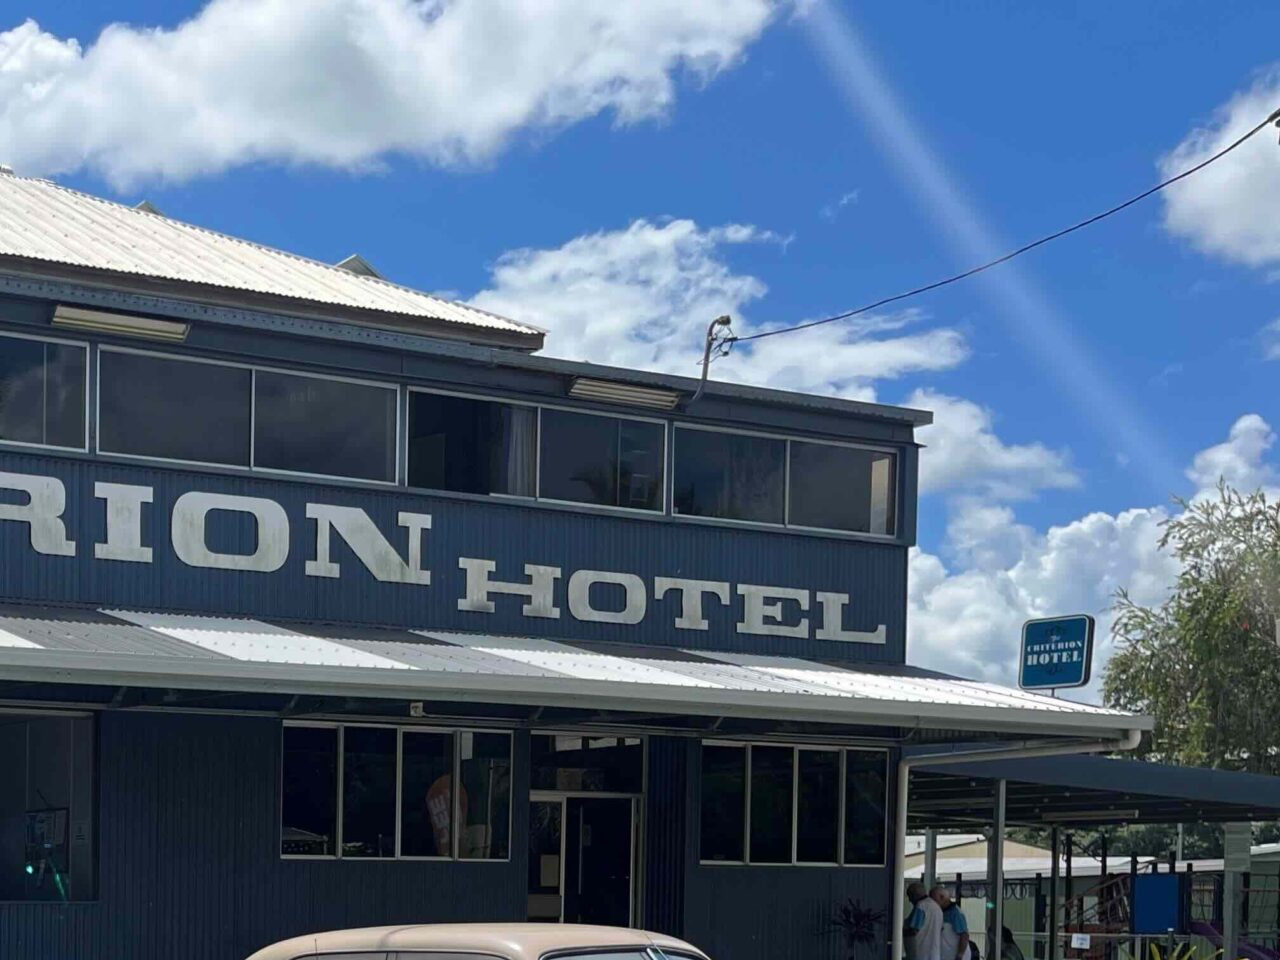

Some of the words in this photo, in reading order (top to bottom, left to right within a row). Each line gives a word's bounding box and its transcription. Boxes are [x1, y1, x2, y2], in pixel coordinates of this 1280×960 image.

[457, 557, 886, 645] HOTEL
[1027, 641, 1082, 653] CRITERION
[1026, 651, 1082, 666] HOTEL
